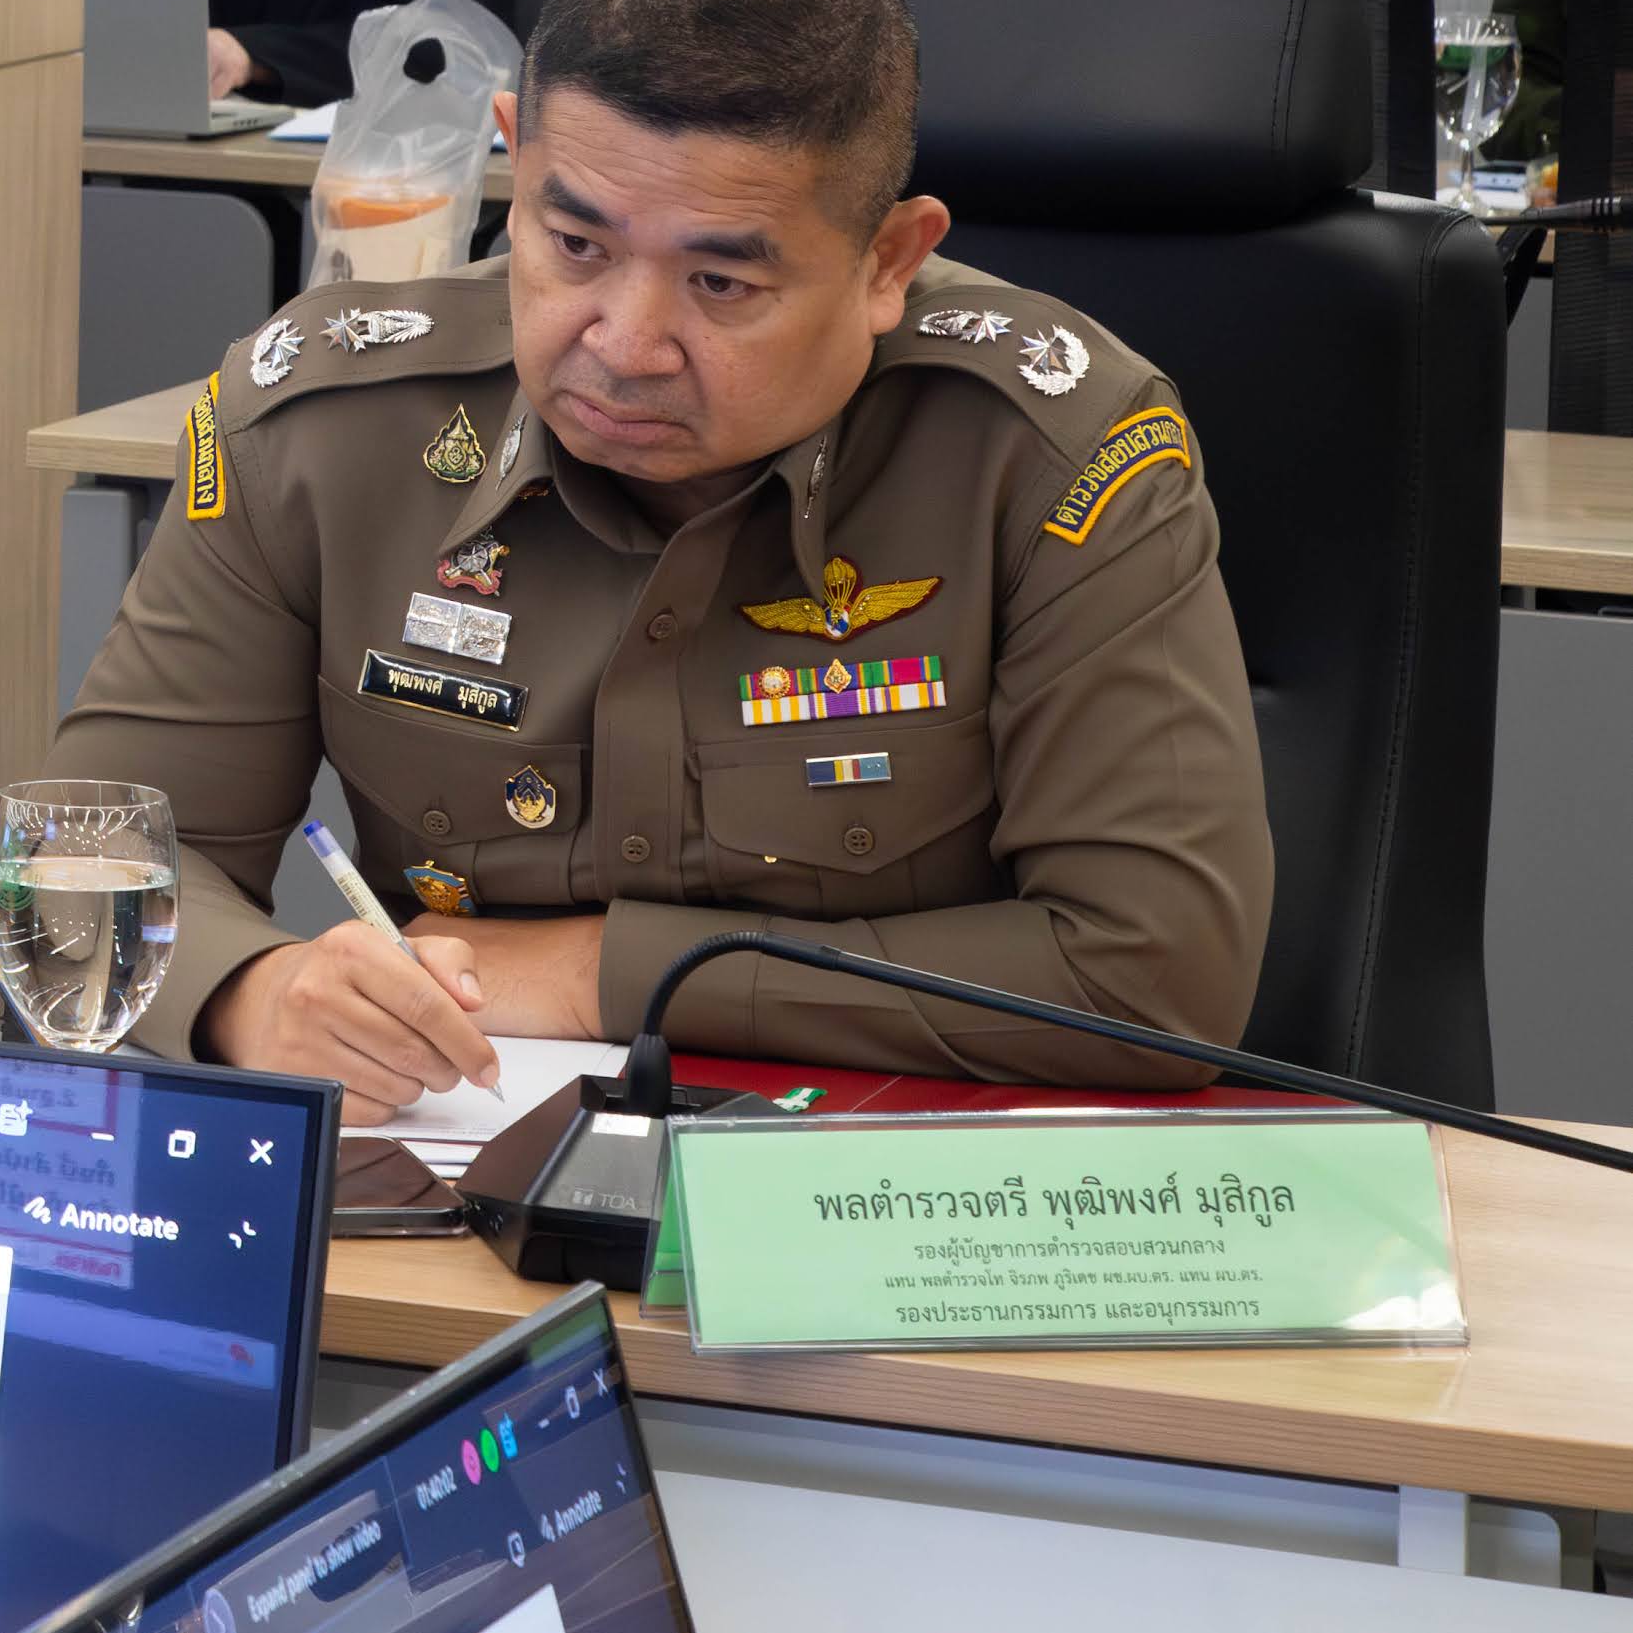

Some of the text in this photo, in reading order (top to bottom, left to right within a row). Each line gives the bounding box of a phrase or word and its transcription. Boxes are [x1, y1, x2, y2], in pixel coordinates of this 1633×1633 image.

[599, 1192, 637, 1209] TOA
[814, 1171, 1296, 1230] พลตำรวจตรี พุฒิพงศ์ มุสิกูล
[60, 1201, 179, 1241] Annotate
[913, 1237, 1226, 1266] รองผู้บัญชาการตำรวจสอบสวนกลาง
[885, 1275, 916, 1289] แทน
[920, 1271, 1004, 1288] พลตำรวจโท
[1179, 1269, 1211, 1283] แทน
[895, 1298, 1260, 1326] รองประธานกรรมการ และอนุกรรมการ
[554, 1488, 603, 1538] Annotate
[247, 1575, 288, 1623] Expand
[325, 1532, 354, 1572] show
[351, 1519, 381, 1555] video
